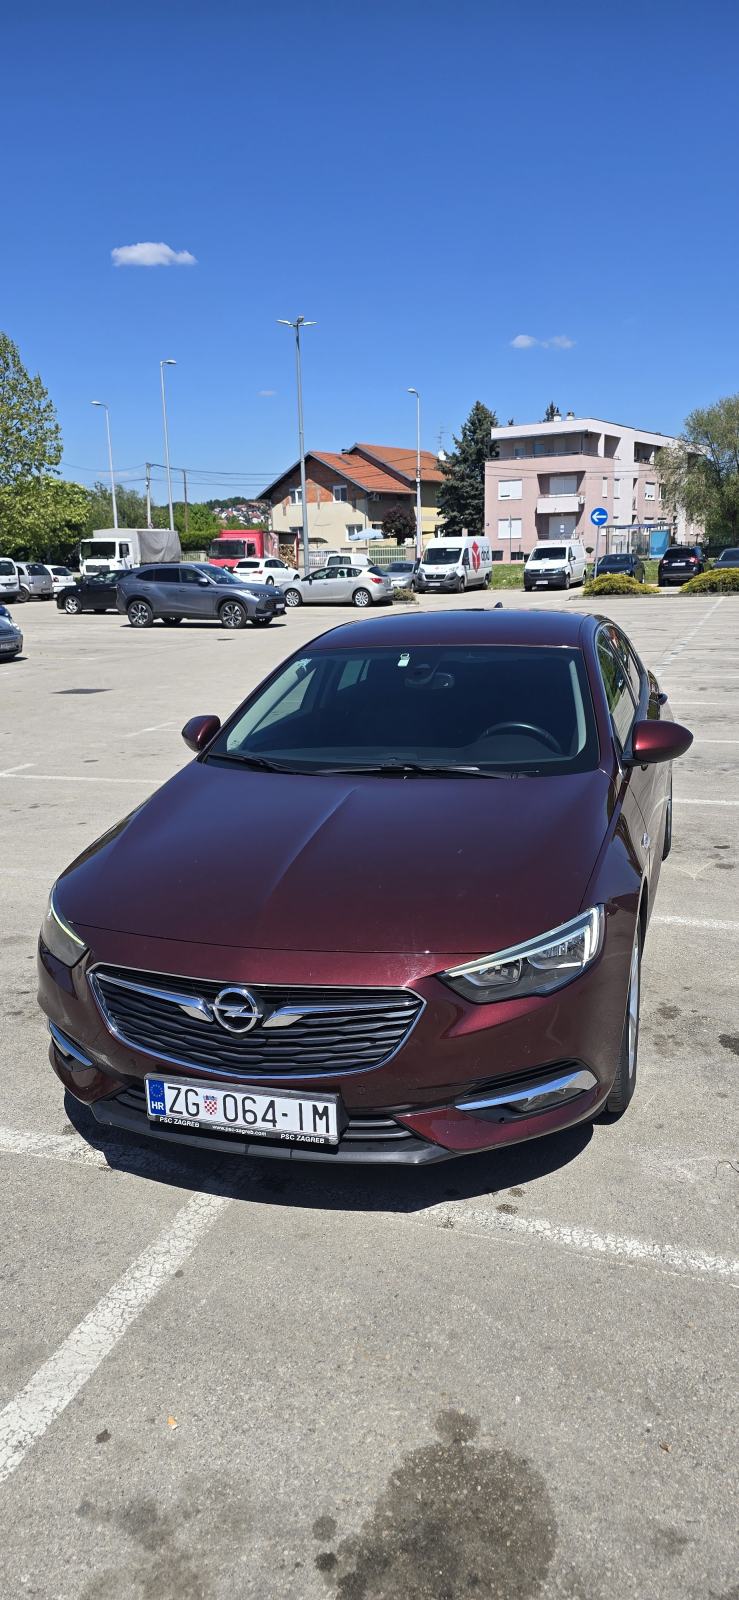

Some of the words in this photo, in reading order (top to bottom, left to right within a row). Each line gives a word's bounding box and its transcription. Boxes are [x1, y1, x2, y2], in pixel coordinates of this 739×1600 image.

[151, 1101, 165, 1111] HR
[167, 1086, 200, 1117] ZG
[222, 1093, 330, 1134] 064-IM
[159, 1116, 173, 1124] PSC
[173, 1118, 200, 1128] ZAGREB
[280, 1133, 295, 1141] PSC
[296, 1134, 325, 1144] ZAGREB
